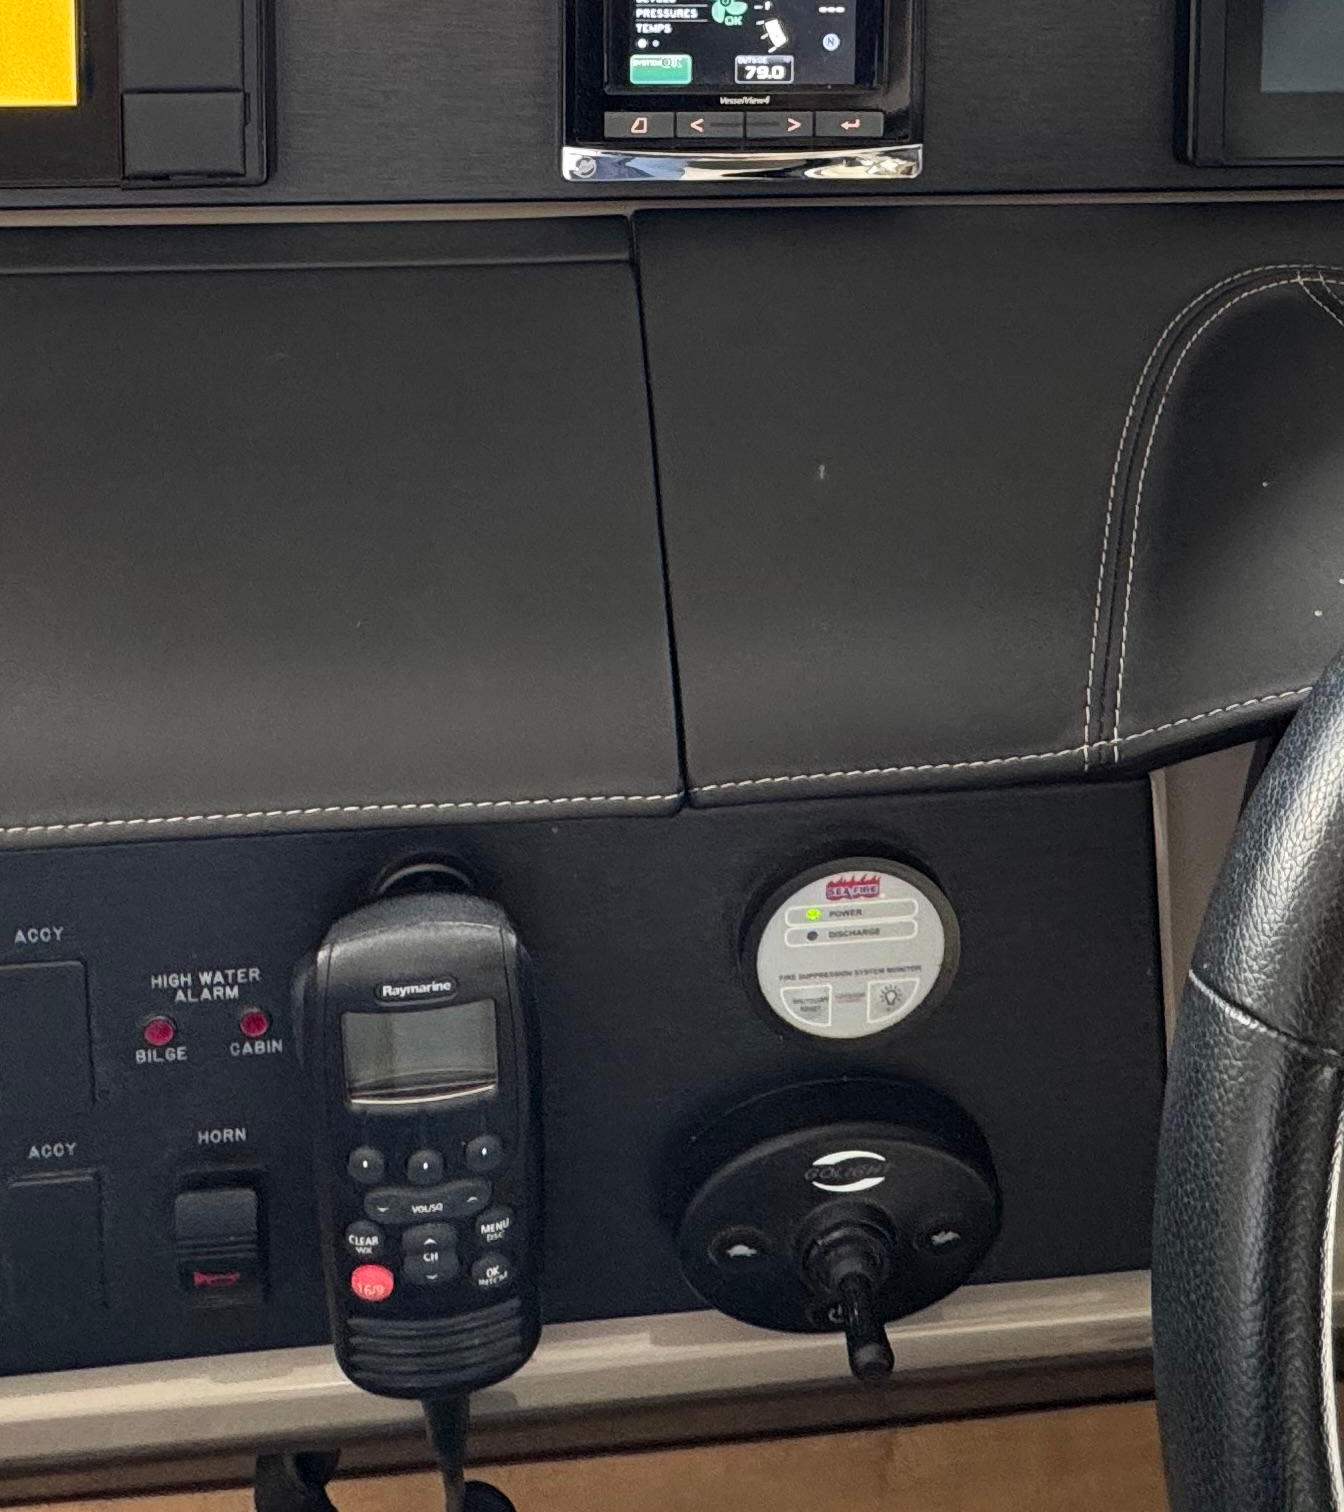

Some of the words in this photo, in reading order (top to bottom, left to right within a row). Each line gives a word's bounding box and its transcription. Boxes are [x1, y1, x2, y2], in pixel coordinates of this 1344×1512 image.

[635, 8, 699, 19] PRESSURES
[723, 15, 743, 27] OK
[635, 23, 673, 34] TEMPS
[744, 64, 786, 80] 79.0
[829, 908, 863, 918] POWER
[13, 926, 65, 944] ACCY
[828, 928, 881, 939] DISCHARGE
[151, 972, 193, 989] HIGH
[198, 967, 261, 987] WATER
[174, 984, 240, 1004] ALARM
[382, 980, 452, 998] Raymarine
[135, 1046, 189, 1065] BILGE
[229, 1039, 284, 1057] CABIN
[197, 1127, 248, 1145] HORN
[27, 1141, 78, 1160] ACCY
[480, 1217, 510, 1235] MENU
[348, 1234, 379, 1247] CLEAR
[423, 1251, 439, 1263] CH
[486, 1264, 500, 1278] OK
